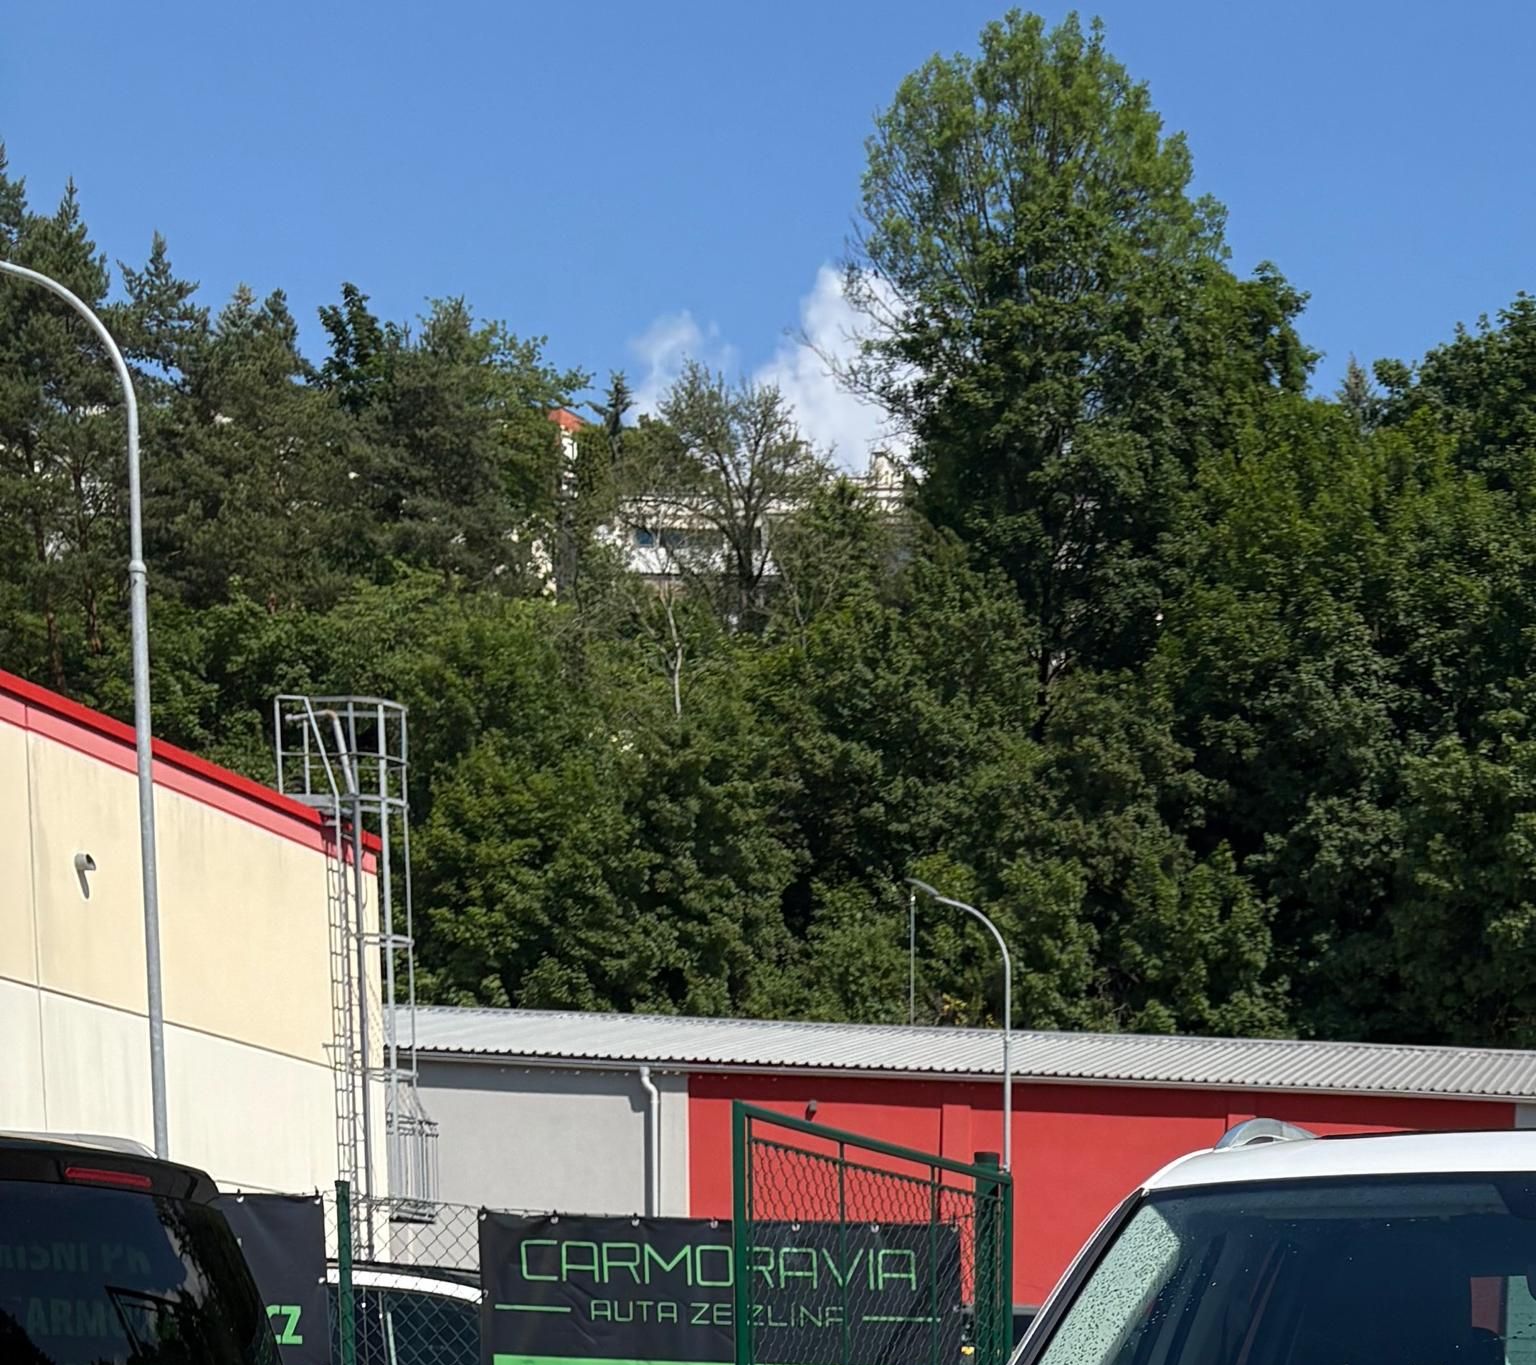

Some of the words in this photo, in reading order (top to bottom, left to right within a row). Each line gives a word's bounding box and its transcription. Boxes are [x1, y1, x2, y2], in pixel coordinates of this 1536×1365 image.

[520, 1239, 918, 1292] CARMORAVIA
[589, 1299, 679, 1323] AUTA
[690, 1302, 733, 1326] ZE
